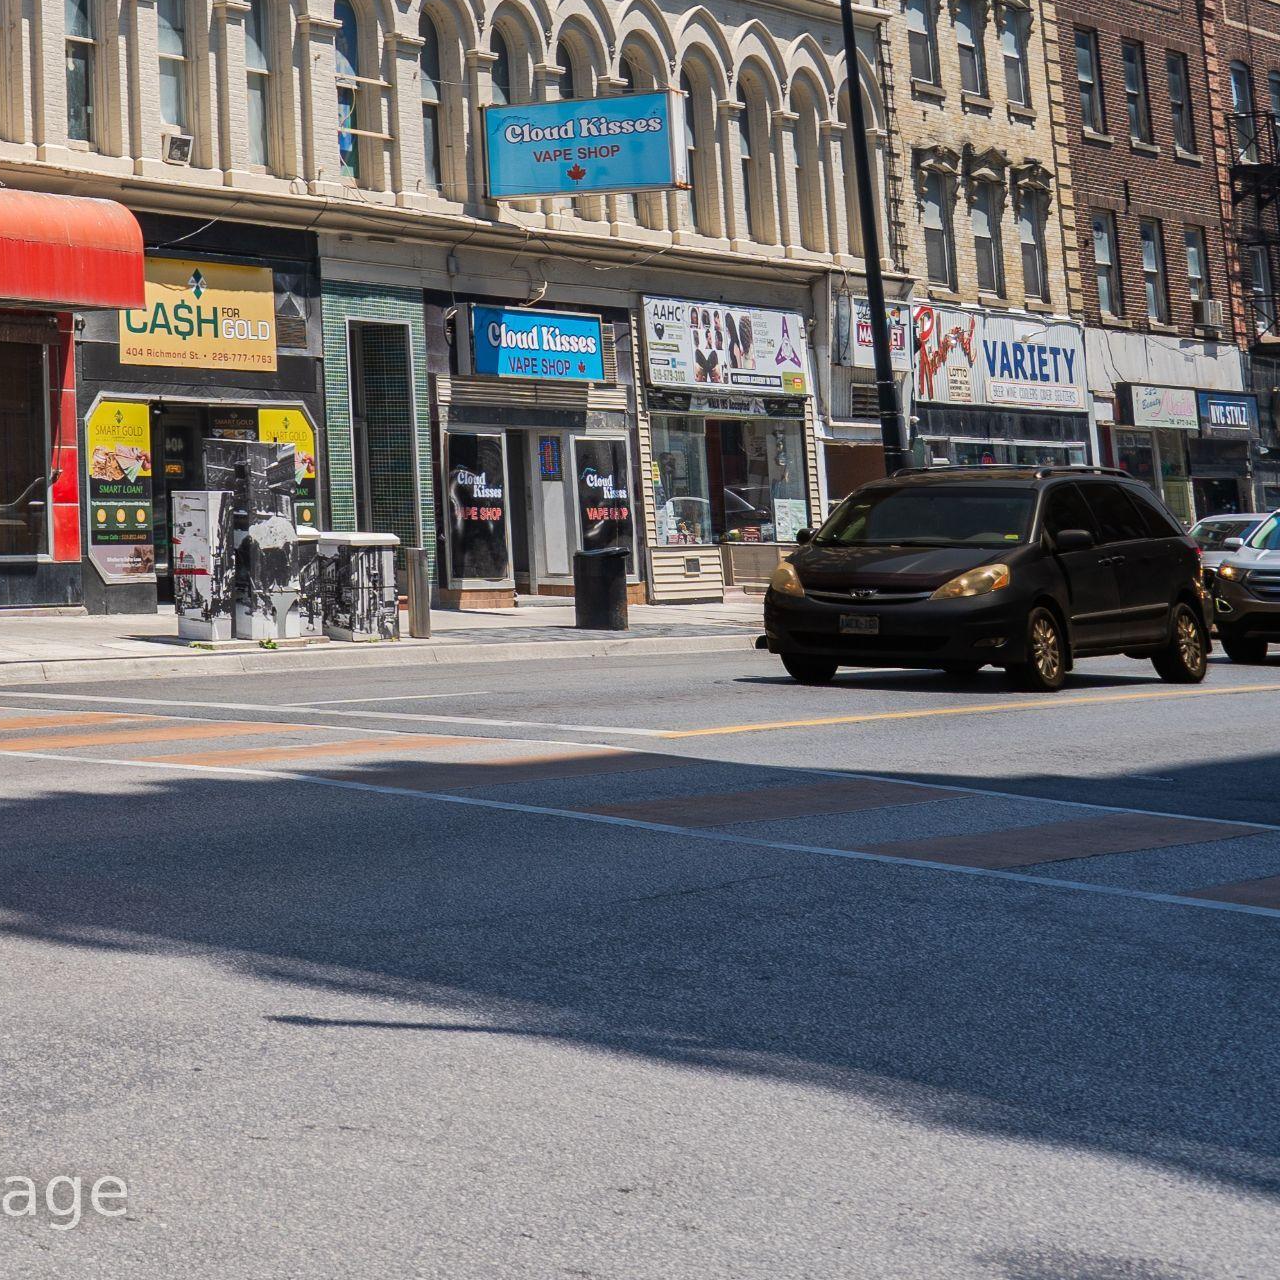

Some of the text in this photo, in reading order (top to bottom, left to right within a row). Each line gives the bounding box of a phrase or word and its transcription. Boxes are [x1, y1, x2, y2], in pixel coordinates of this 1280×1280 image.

[505, 116, 663, 143] Cloud Kisses
[533, 144, 620, 162] VAPE SHOP
[222, 307, 240, 318] FOR
[222, 319, 270, 341] GOLD
[859, 325, 903, 346] MAET
[488, 321, 597, 354] Cloud Kisses
[126, 347, 143, 356] 404
[147, 348, 186, 359] Richmond
[508, 356, 571, 376] VAPE SHOP
[983, 339, 1075, 384] VARIETY
[949, 368, 968, 378] LOTTO
[1210, 405, 1225, 425] NYC
[1226, 406, 1248, 426] STYLZ
[96, 425, 143, 436] SMART GOLD
[266, 431, 308, 441] SMART GOLD
[457, 471, 486, 485] Cloud
[586, 474, 613, 488] Cloud
[99, 485, 144, 494] SMART LOAN!
[473, 484, 502, 498] Kisses
[603, 486, 628, 499] Kisses
[480, 507, 502, 520] SHOP
[586, 507, 628, 520] VAPE SHOP
